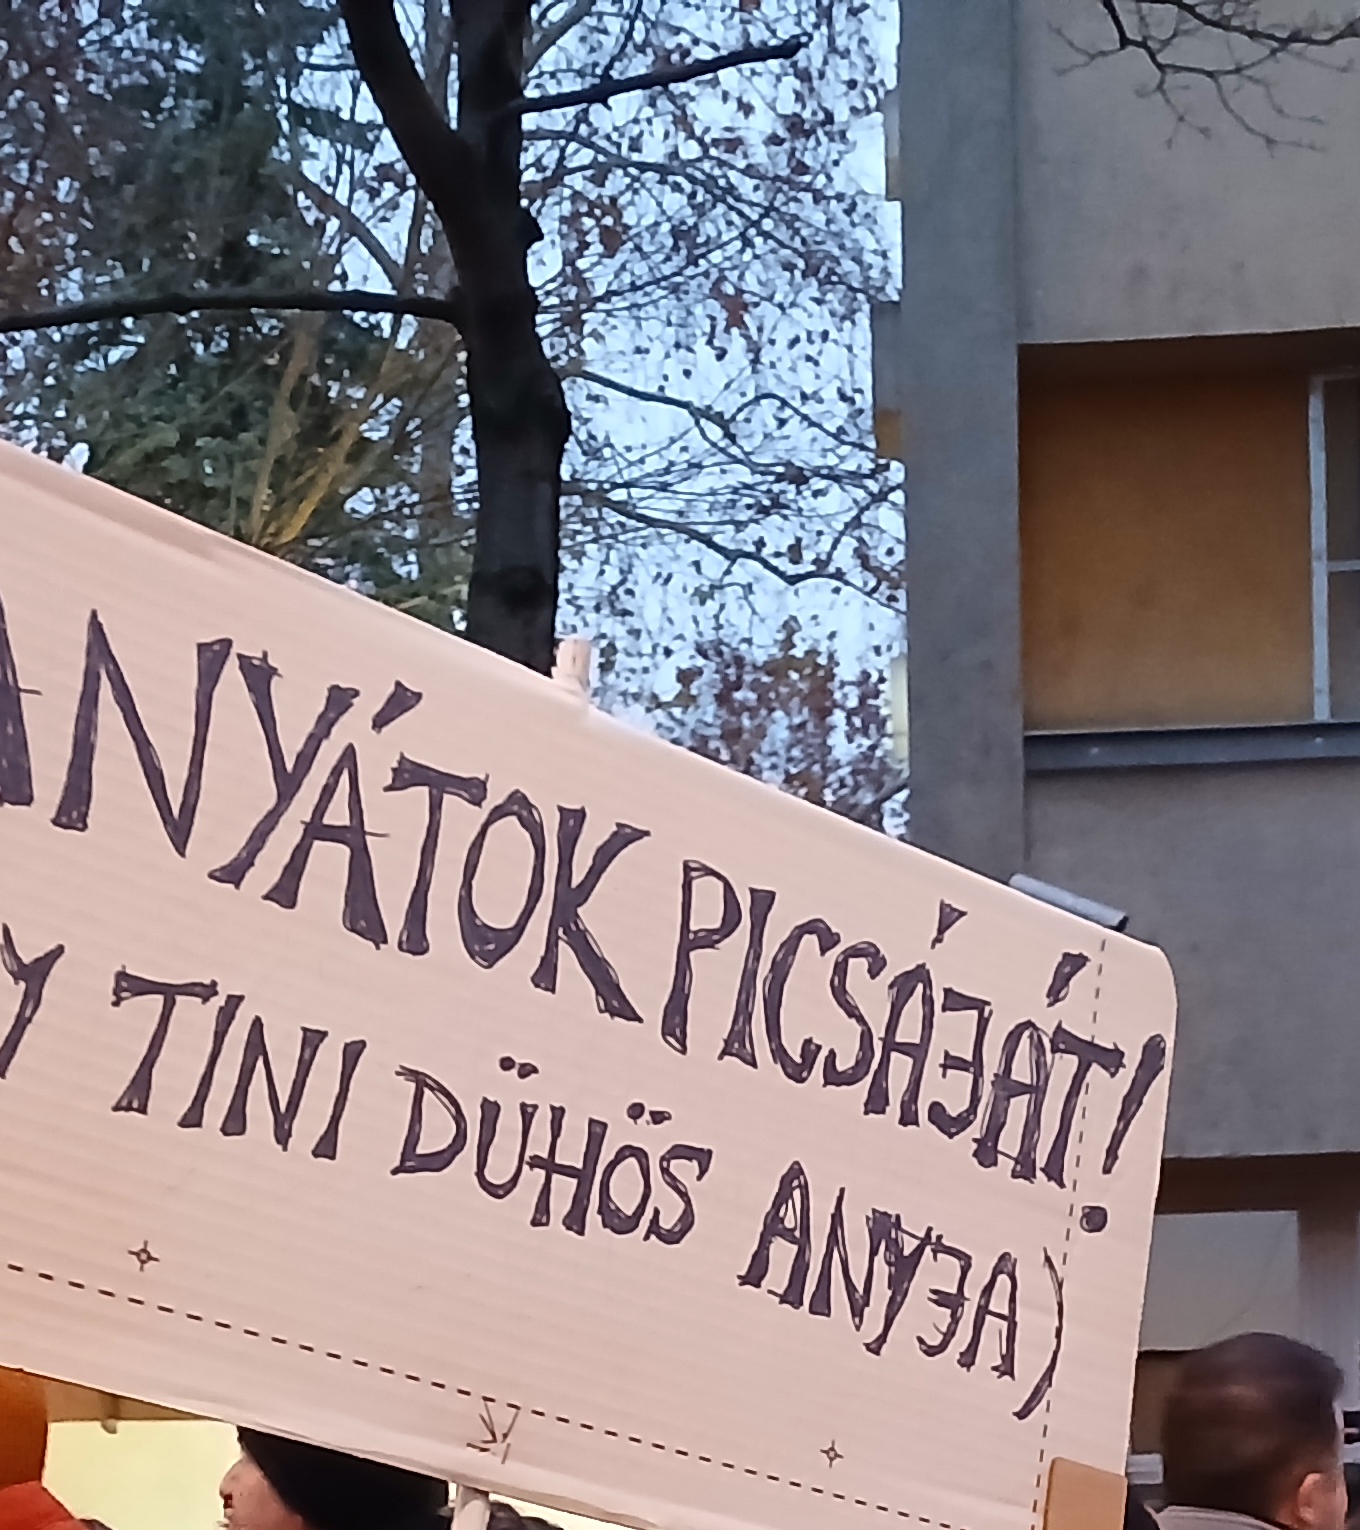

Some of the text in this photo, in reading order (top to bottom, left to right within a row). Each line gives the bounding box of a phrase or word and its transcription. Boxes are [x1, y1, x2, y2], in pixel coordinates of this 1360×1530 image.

[111, 964, 368, 1162] TINI
[390, 1055, 714, 1245] DÜHÖS
[660, 859, 1168, 1234] PICSÁJÁT!
